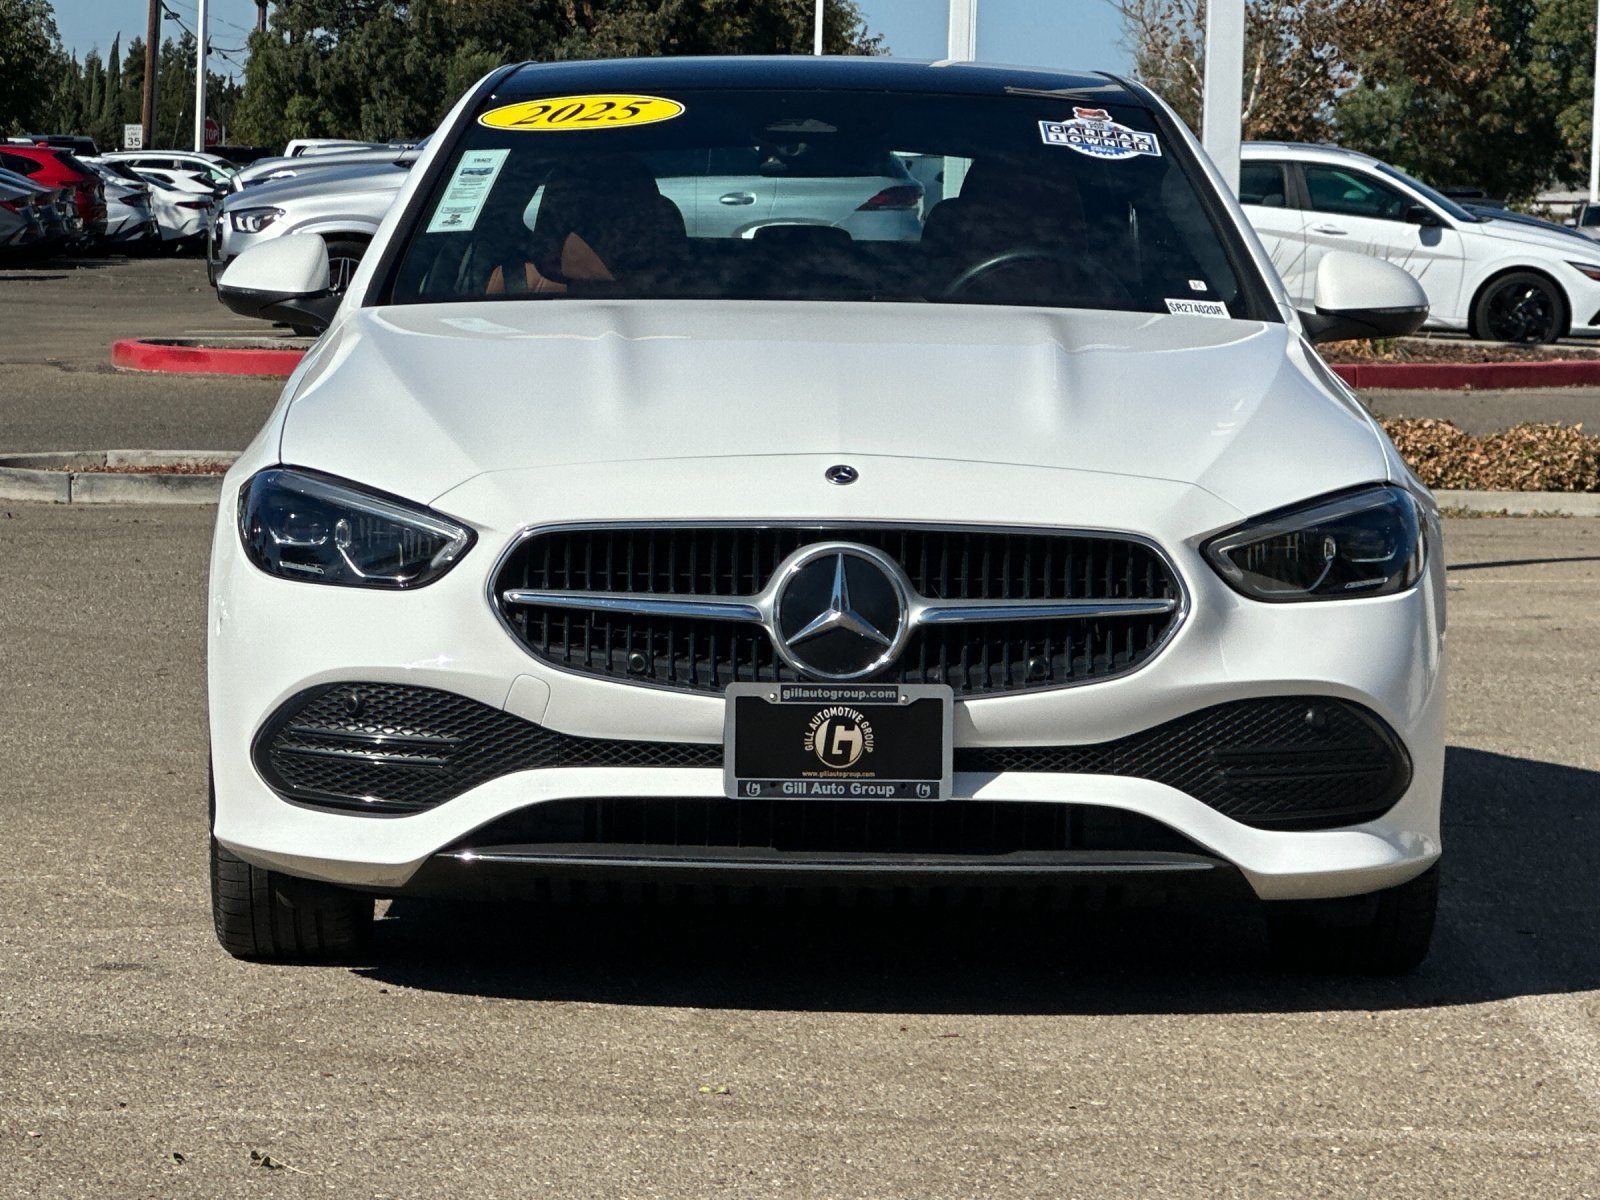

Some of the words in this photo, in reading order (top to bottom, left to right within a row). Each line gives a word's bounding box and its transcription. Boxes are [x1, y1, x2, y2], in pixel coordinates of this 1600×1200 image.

[509, 101, 654, 126] 2025
[205, 128, 218, 139] TOP
[1049, 124, 1149, 143] CARFAX
[127, 137, 141, 146] 35
[1069, 135, 1150, 152] OWNER
[1169, 302, 1224, 315] SR274020R
[782, 686, 896, 700] gillautogroup.com
[803, 731, 815, 751] GILL
[809, 706, 864, 731] AUTOMOTIVE
[860, 721, 875, 753] GROUP
[802, 770, 876, 778] www.gillautogroup.com
[782, 782, 807, 795] Gill
[811, 782, 845, 795] Auto
[850, 782, 896, 797] Group
